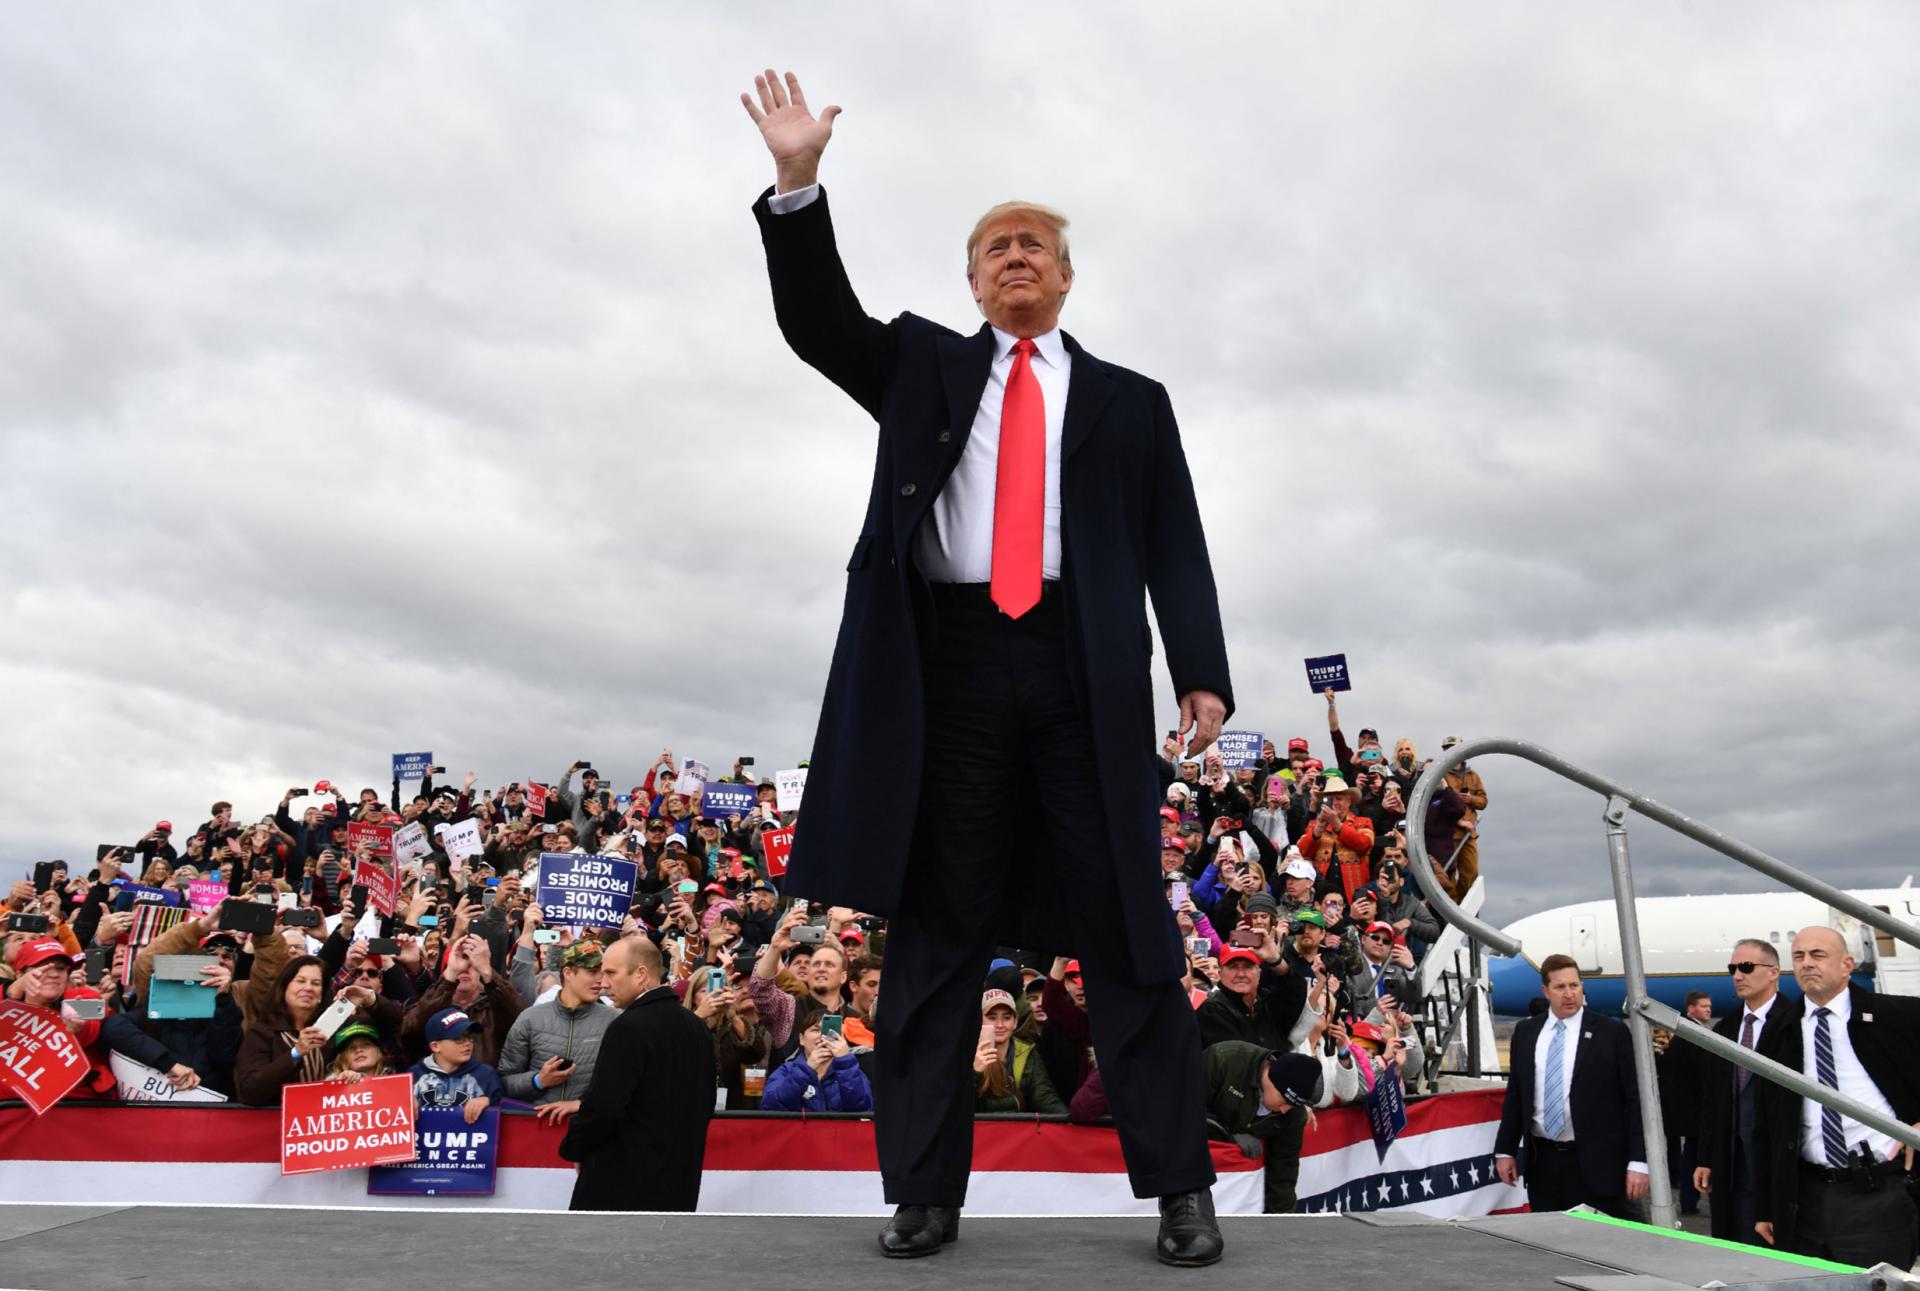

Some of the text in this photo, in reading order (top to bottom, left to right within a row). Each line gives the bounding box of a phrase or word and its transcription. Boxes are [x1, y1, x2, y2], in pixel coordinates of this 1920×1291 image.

[1309, 665, 1343, 675] TRUMP
[707, 792, 753, 802] TRUMP
[399, 833, 423, 849] TRUMP
[570, 860, 613, 876] KEPT
[190, 883, 228, 895] WOMEN
[548, 873, 629, 893] PROMISES
[136, 890, 164, 901] KEEP
[564, 891, 613, 908] MADE
[545, 905, 624, 924] PROMISES
[0, 1008, 78, 1067] FINISH
[13, 1032, 42, 1053] THE
[144, 1077, 178, 1100] BUY
[1387, 1080, 1398, 1114] GREAT
[322, 1092, 373, 1109] MAKE
[286, 1106, 409, 1138] AMERICA
[285, 1130, 411, 1157] PROUD AGAIN
[416, 1150, 477, 1160] ENCE
